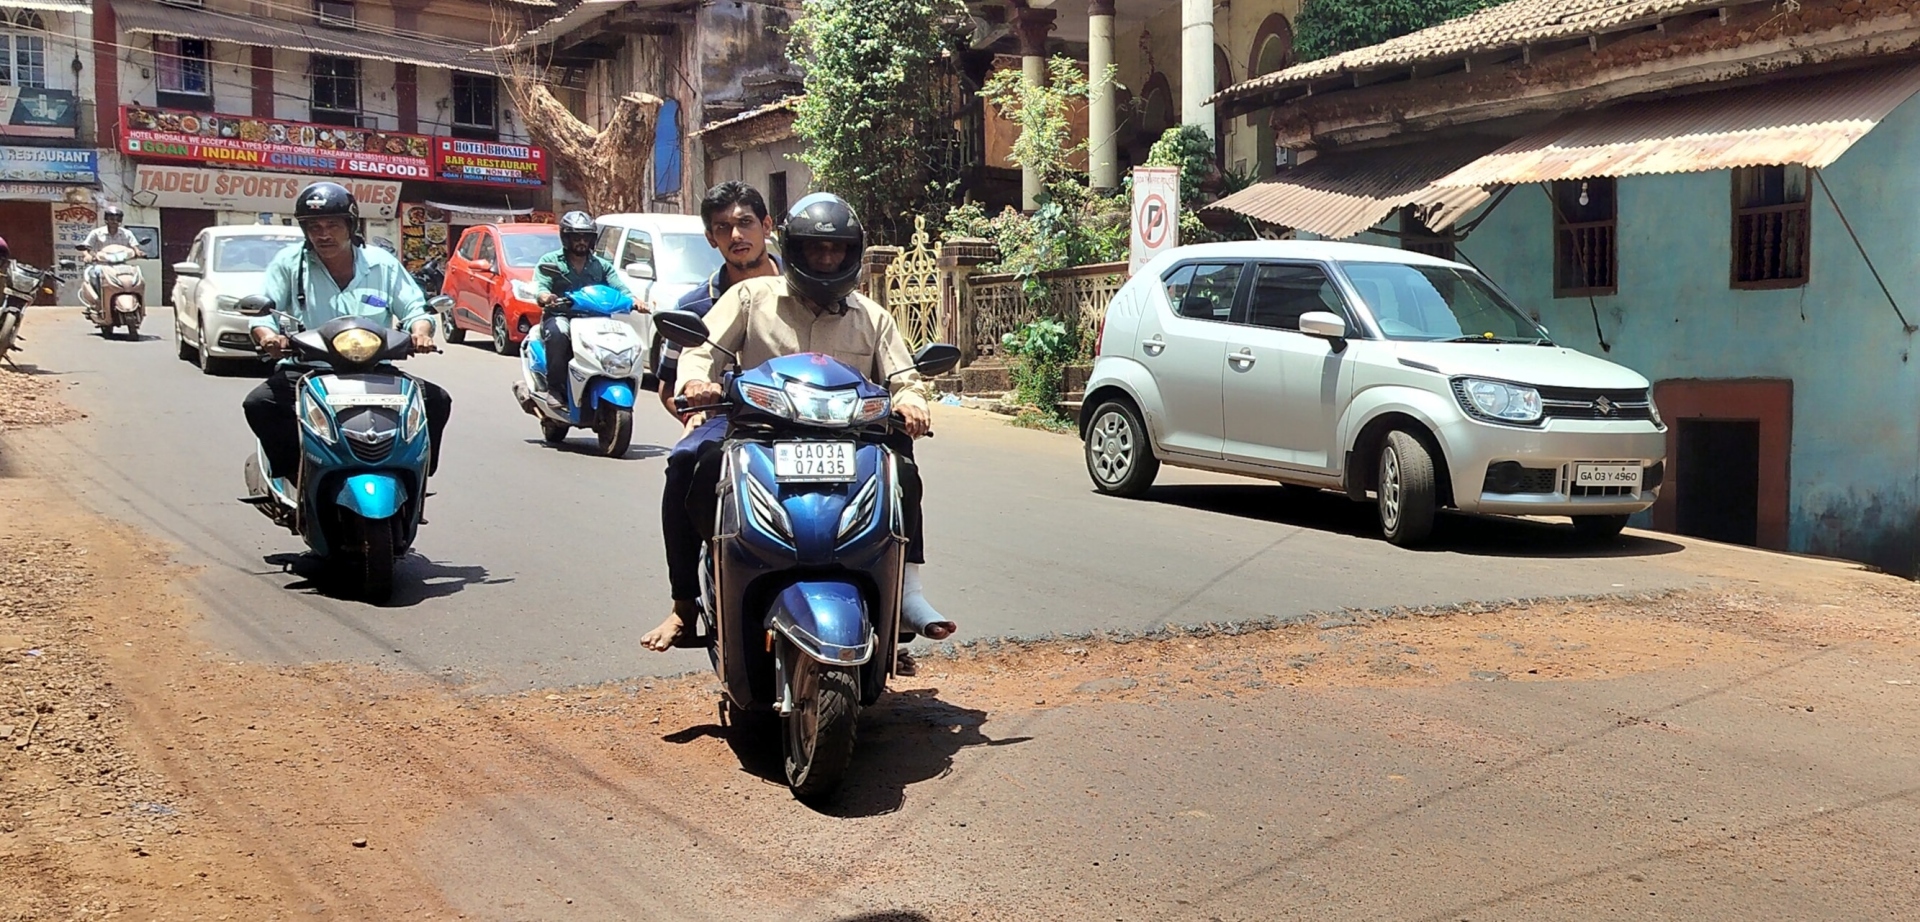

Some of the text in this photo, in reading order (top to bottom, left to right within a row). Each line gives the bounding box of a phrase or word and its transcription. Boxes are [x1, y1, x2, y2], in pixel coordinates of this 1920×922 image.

[130, 131, 152, 140] HOTEL
[200, 138, 227, 146] ACCEPT
[228, 140, 240, 148] ALL
[241, 141, 262, 150] TYPES
[273, 144, 293, 152] PARTY
[293, 146, 315, 154] ORDER
[320, 149, 353, 158] TAKEAWAY
[455, 141, 528, 158] HOTEL BHOSALE
[7, 149, 90, 162] RESTAURANT
[143, 140, 188, 156] GOAN
[202, 146, 258, 161] INDIAN
[270, 153, 337, 169] CHINESE
[349, 160, 417, 176] SEAFOOD
[445, 155, 538, 171] BAR & RESTAURANT
[464, 166, 481, 174] VEG
[485, 168, 503, 176] NON
[10, 185, 64, 194] RESTAUR
[138, 169, 210, 194] TADEU
[214, 174, 299, 199] SPORTS
[338, 182, 397, 205] AMES
[795, 444, 844, 459] GA03A
[1580, 471, 1637, 481] GA 03 Y 4960
